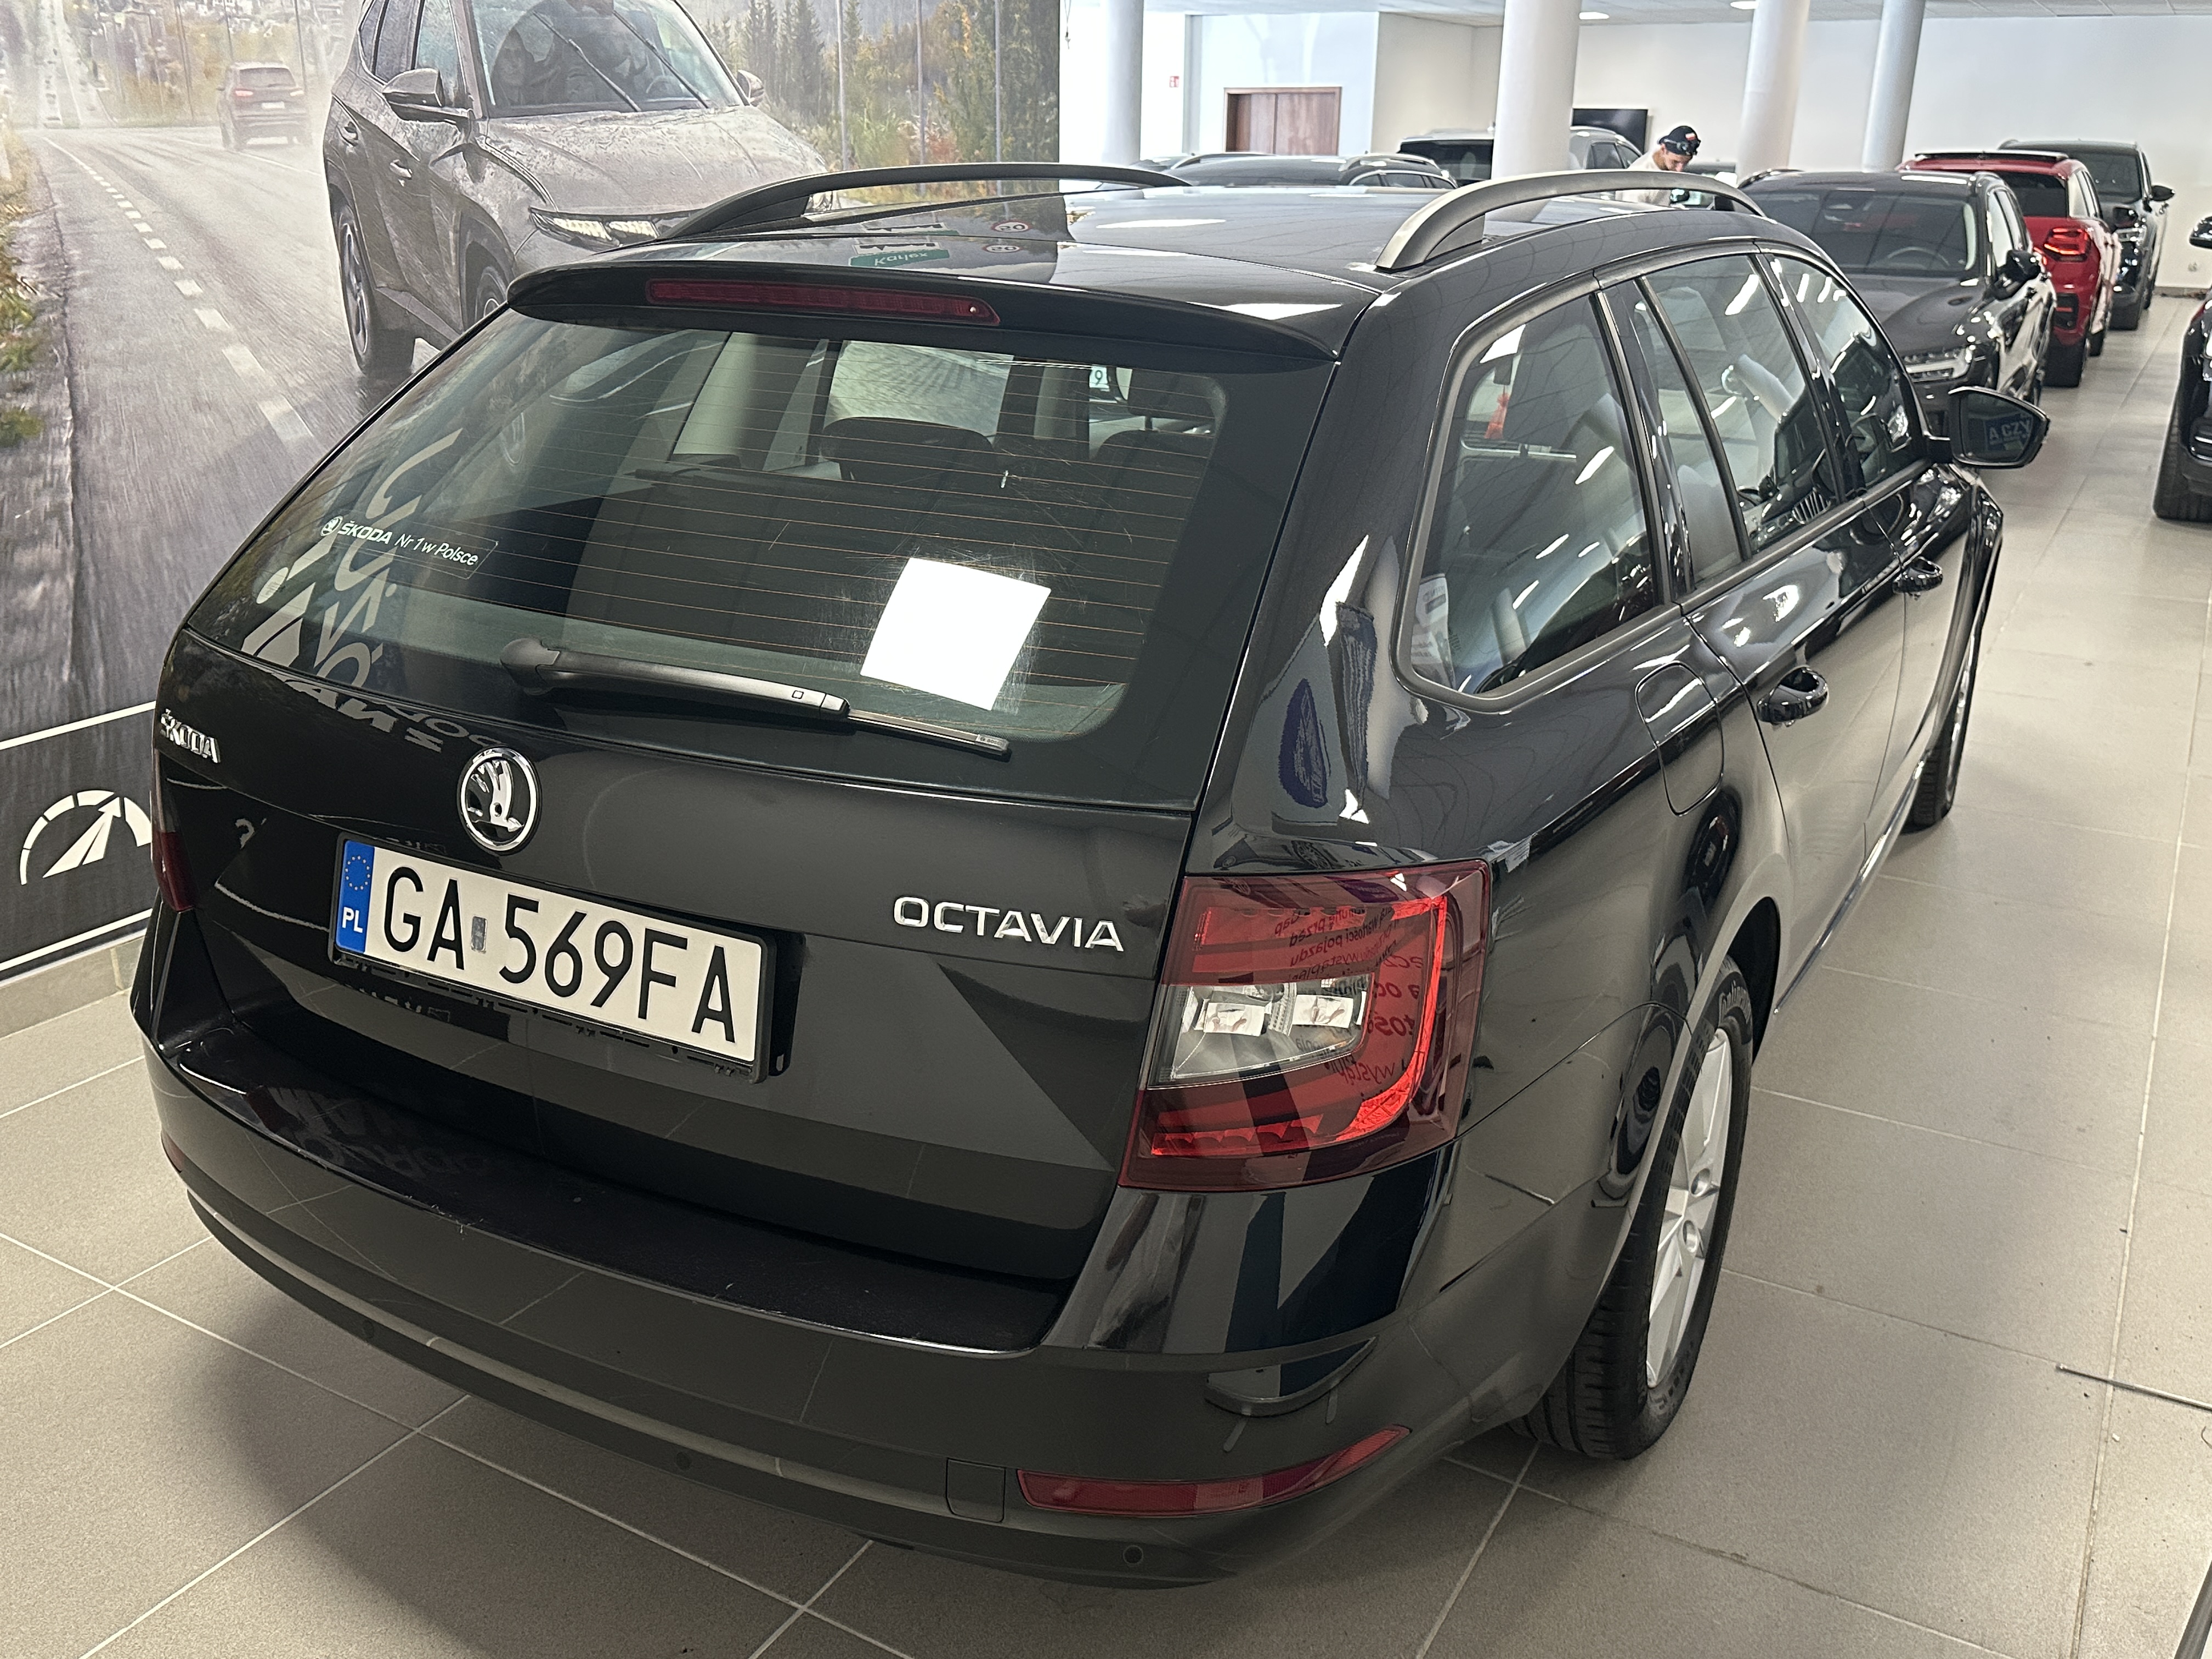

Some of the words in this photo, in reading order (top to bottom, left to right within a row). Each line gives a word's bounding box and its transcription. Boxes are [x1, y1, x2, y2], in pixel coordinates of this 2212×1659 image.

[337, 520, 393, 545] ŠKODA
[394, 533, 415, 549] Nr
[413, 537, 425, 551] 1
[422, 541, 437, 554] w
[434, 542, 479, 566] Polsce
[160, 708, 221, 764] ŠKODA
[342, 908, 363, 934] PL
[894, 895, 1124, 952] OCTAVIA
[383, 866, 465, 970] GA
[499, 893, 736, 1043] 569FA
